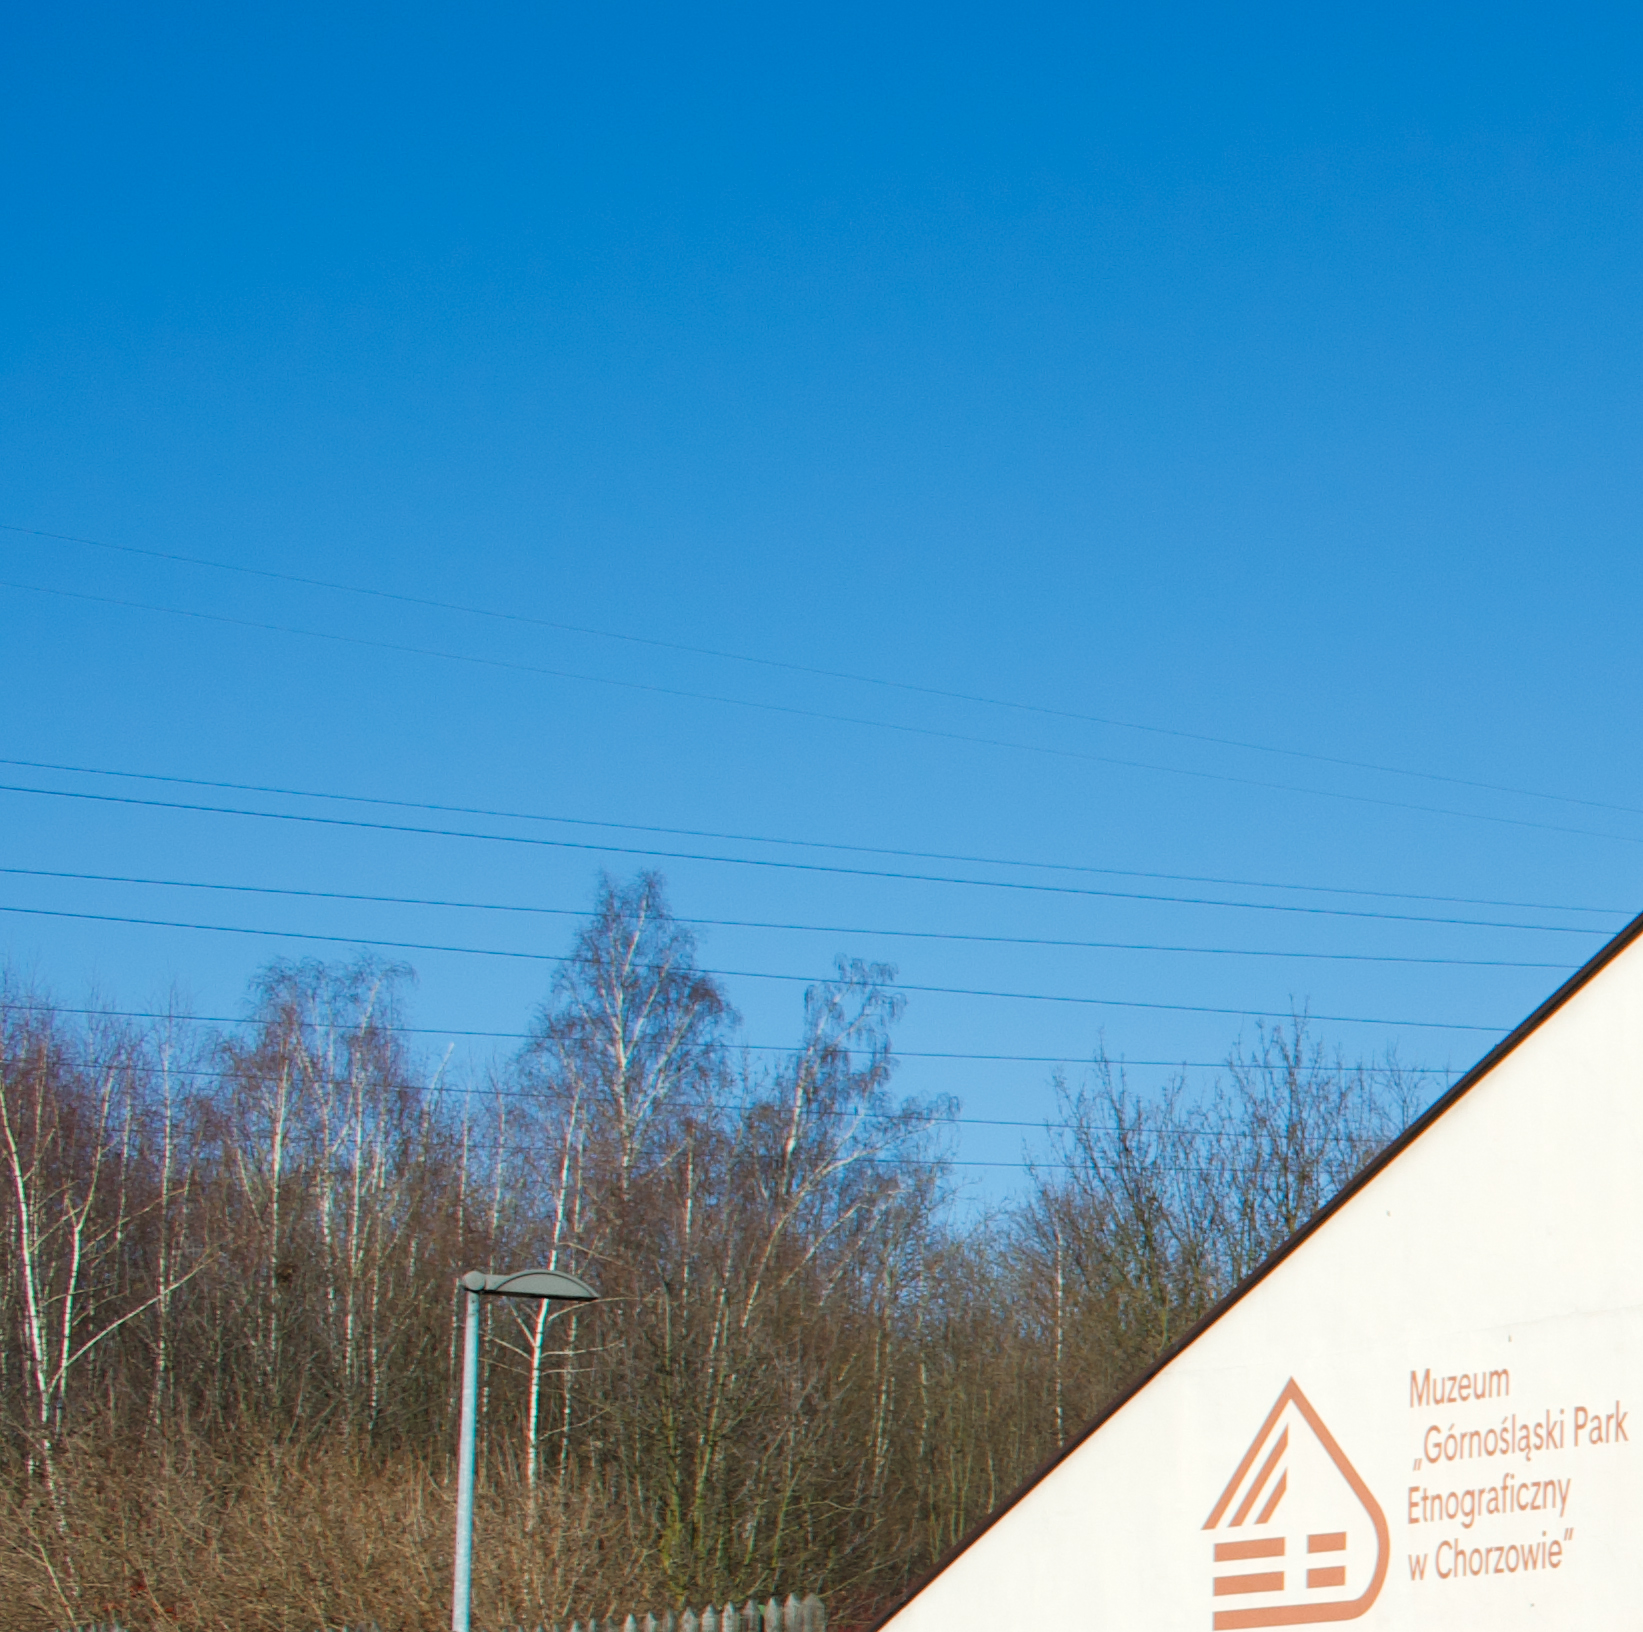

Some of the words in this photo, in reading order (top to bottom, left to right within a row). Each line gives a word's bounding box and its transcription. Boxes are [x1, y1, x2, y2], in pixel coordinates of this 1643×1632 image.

[1409, 1368, 1510, 1408] Muzeum
[1573, 1400, 1629, 1447] Park
[1407, 1472, 1571, 1529] Etnograficzny
[1408, 1552, 1428, 1581] w
